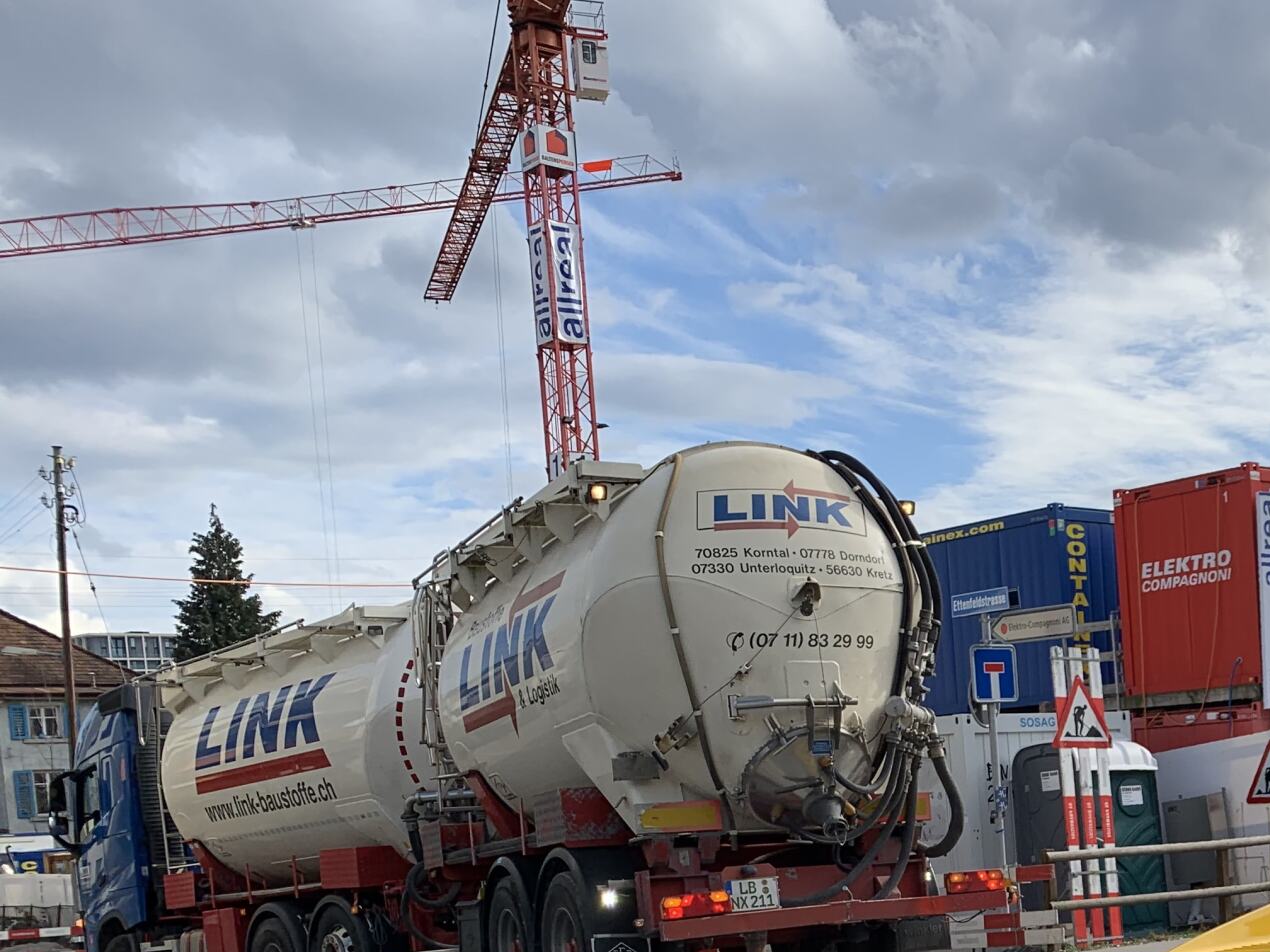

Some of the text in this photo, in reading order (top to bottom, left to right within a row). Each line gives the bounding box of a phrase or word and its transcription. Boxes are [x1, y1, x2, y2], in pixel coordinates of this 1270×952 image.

[551, 224, 583, 339] allreal
[714, 494, 853, 528] LINK
[922, 521, 1005, 545] ainex.com
[695, 548, 738, 559] 70825
[744, 547, 790, 559] Korntal
[800, 548, 836, 560] 07778
[1141, 550, 1232, 579] ELEKTRO
[691, 563, 894, 581] 07330 Unterloquitz 56630 Kretz
[1142, 568, 1232, 593] COMPAGNONI
[953, 594, 1006, 611] Ettenfeldstrasse
[460, 594, 557, 711] LINK
[750, 632, 874, 649] (07 11) 83 29 99
[519, 674, 561, 709] & Logistik
[195, 672, 337, 771] LINK
[1020, 717, 1056, 728] SOSAG
[205, 777, 338, 823] www.link-baustoffe.ch
[739, 881, 757, 895] LB
[731, 894, 775, 911] NX 211
